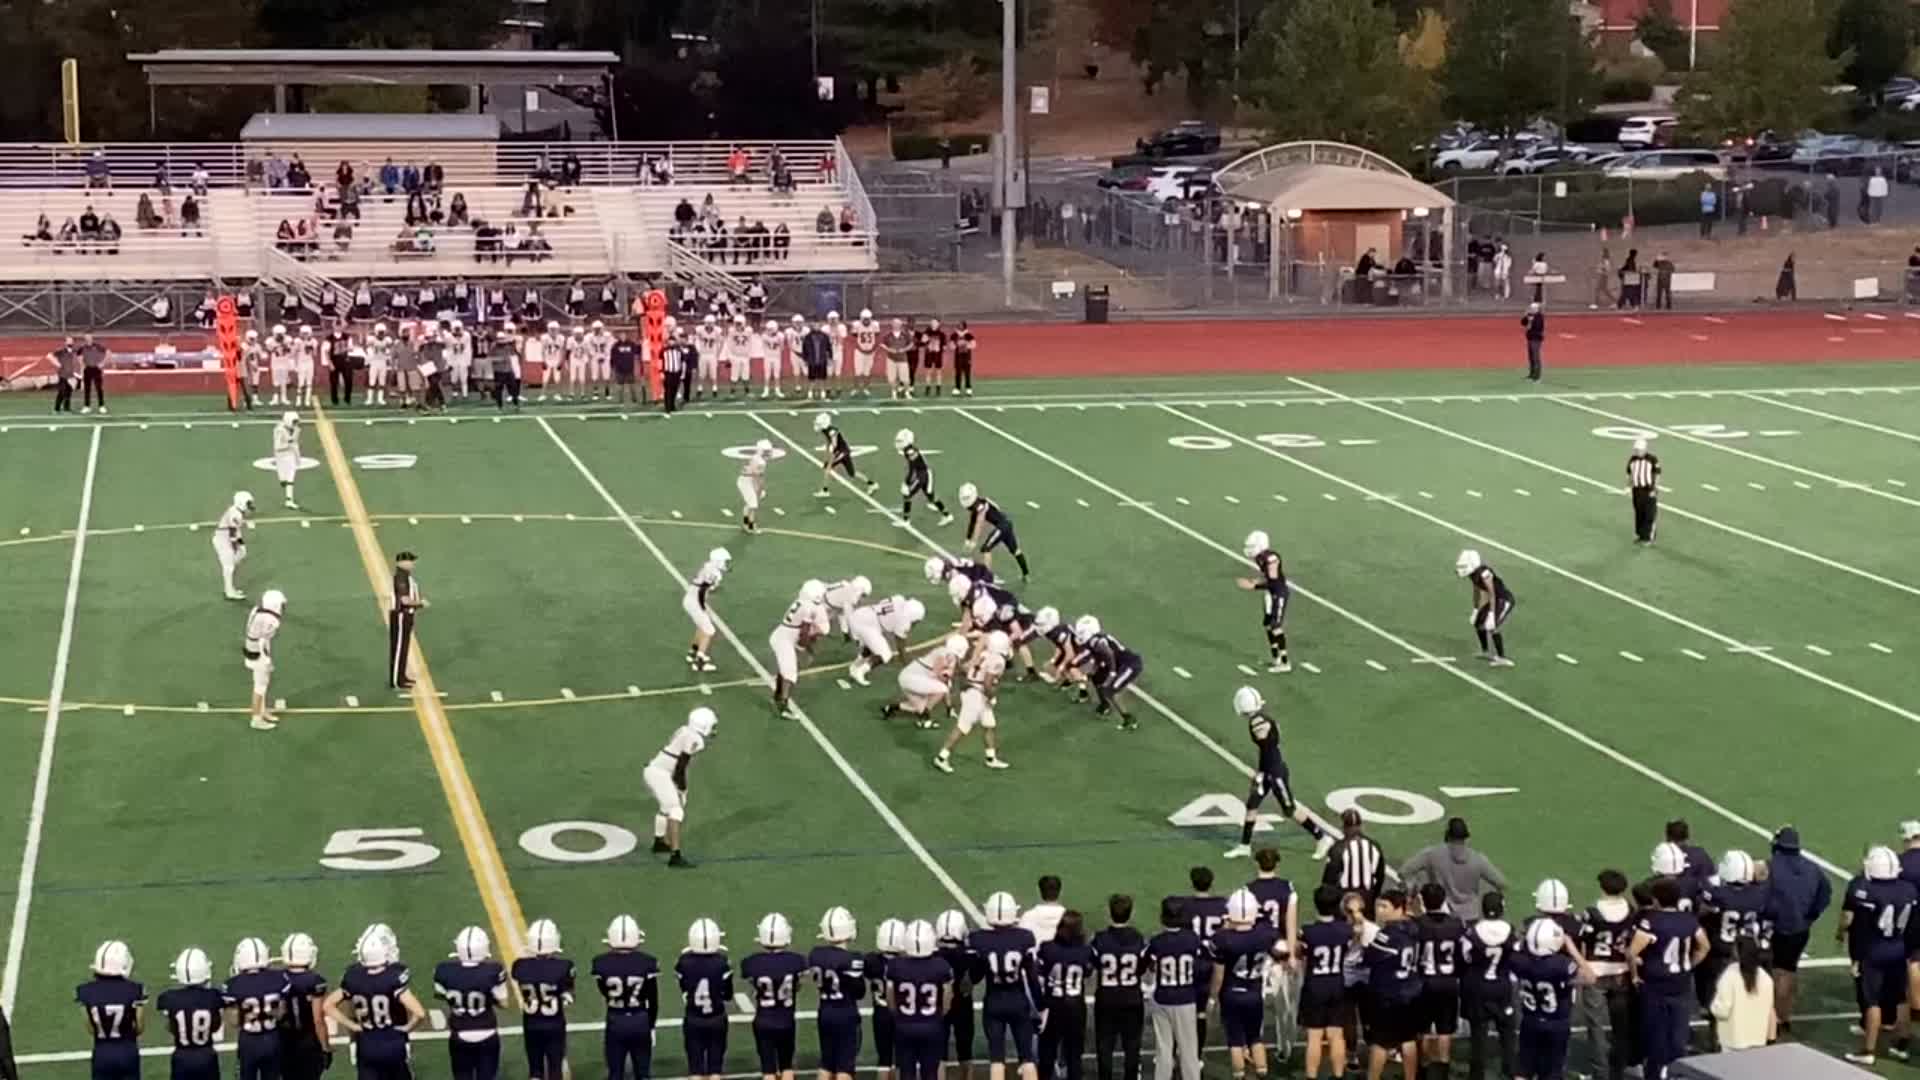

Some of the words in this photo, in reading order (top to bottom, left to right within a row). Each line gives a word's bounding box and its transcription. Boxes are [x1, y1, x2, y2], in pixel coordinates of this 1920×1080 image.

[988, 951, 1023, 984] 19
[1100, 953, 1138, 987] 22
[1312, 946, 1342, 975] 31
[1484, 946, 1504, 980] 7
[605, 976, 645, 1009] 27
[694, 978, 714, 1014] 4
[1047, 962, 1084, 997] 40
[898, 981, 938, 1016] 33
[90, 1004, 126, 1039] 17
[175, 1009, 212, 1046] 18
